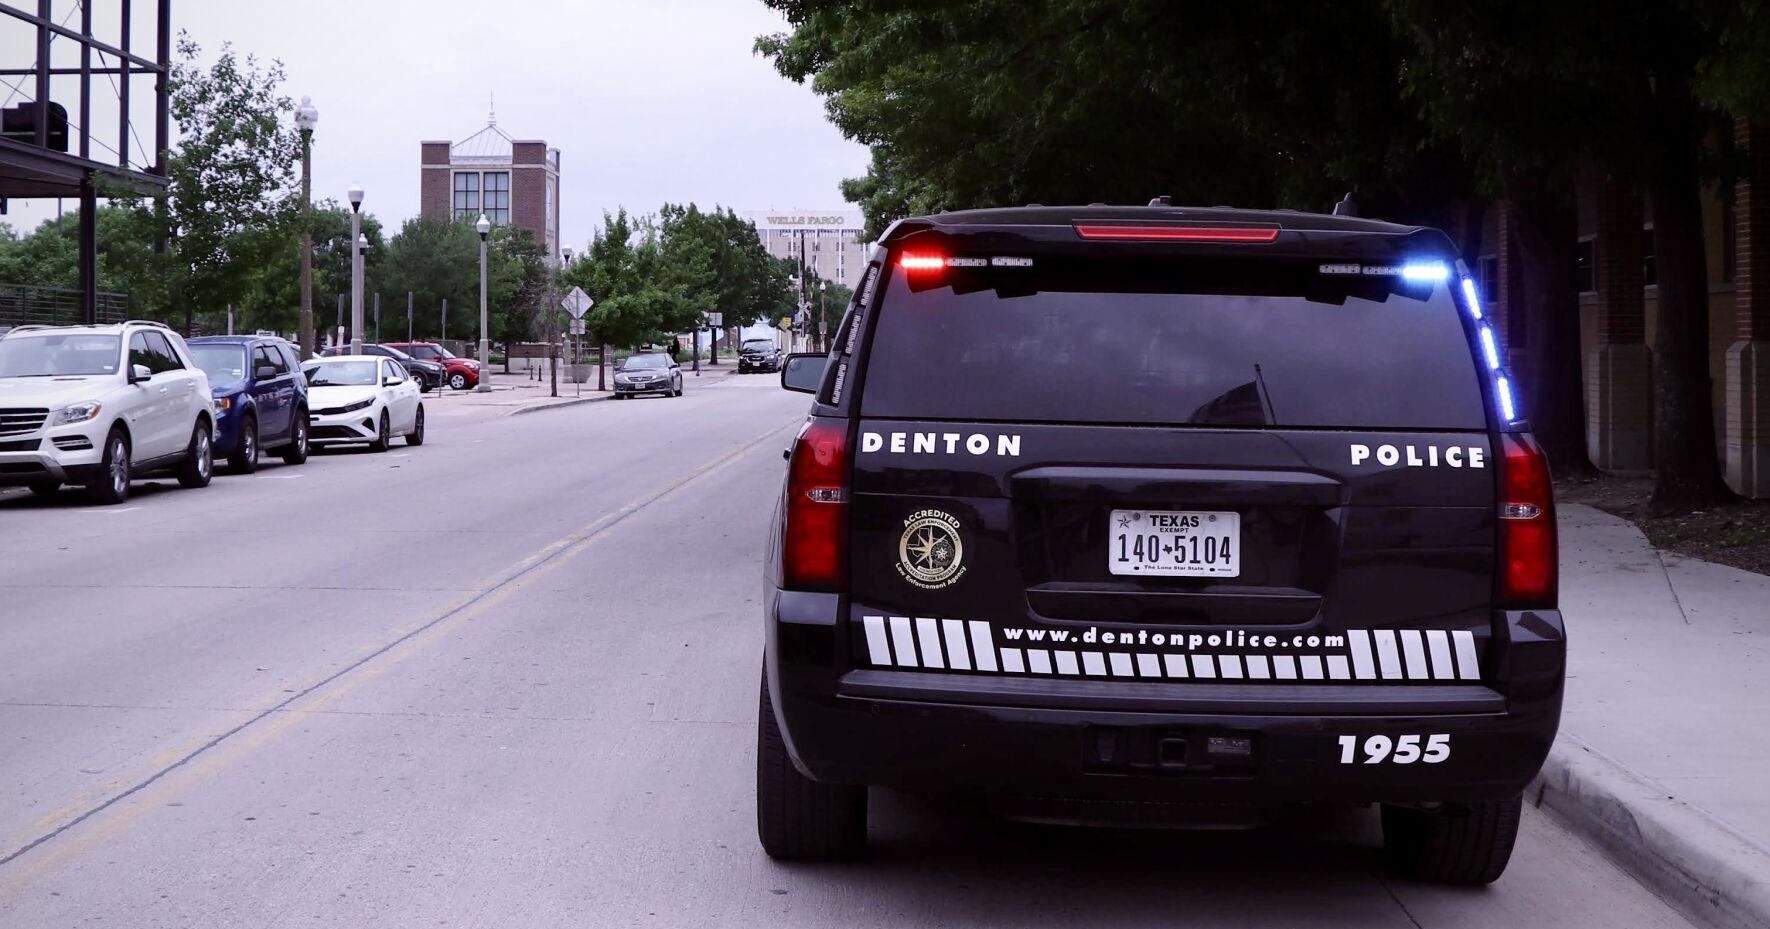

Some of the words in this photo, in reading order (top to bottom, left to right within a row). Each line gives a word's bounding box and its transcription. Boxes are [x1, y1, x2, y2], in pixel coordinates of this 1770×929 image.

[767, 216, 805, 225] WELLS
[807, 216, 844, 225] FARGO
[862, 432, 1021, 457] DENTON
[1350, 444, 1485, 468] POLICE
[904, 509, 961, 529] ACCREDITED
[1150, 514, 1199, 527] TEXAS
[895, 562, 906, 576] Law
[905, 575, 947, 590] Enforcement
[947, 566, 967, 586] Agency
[1003, 627, 1345, 650] www.dentonpolice.com
[1338, 733, 1451, 765] 1955
